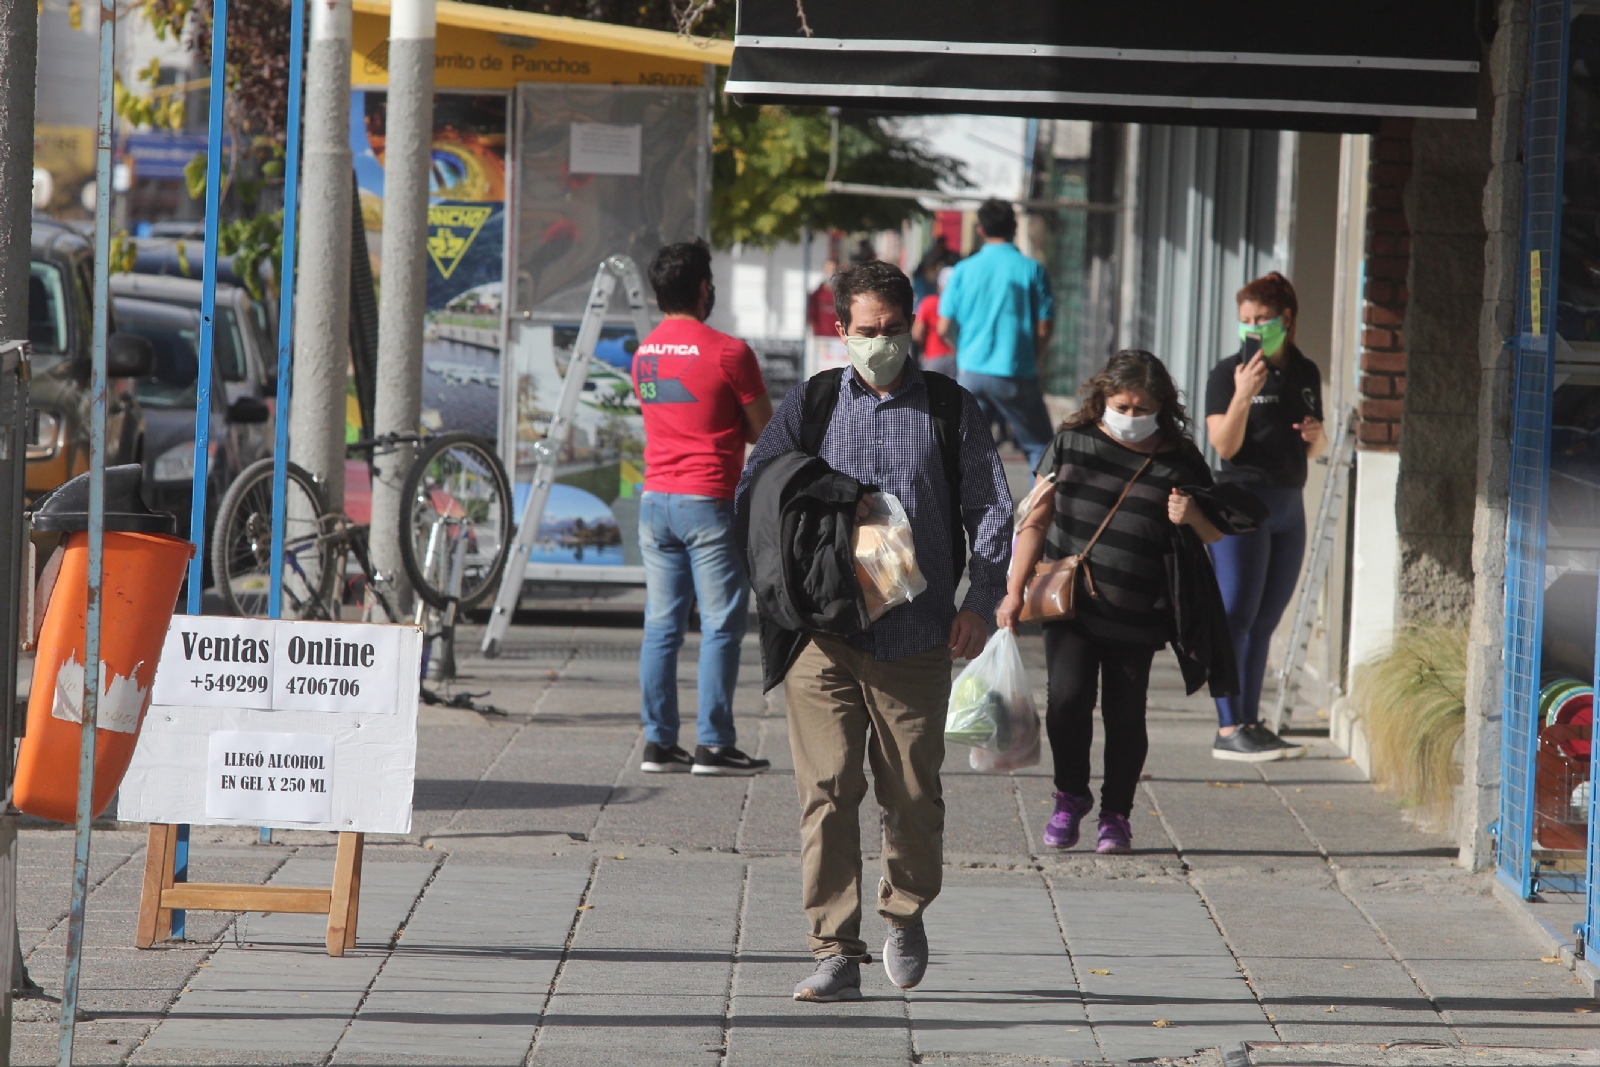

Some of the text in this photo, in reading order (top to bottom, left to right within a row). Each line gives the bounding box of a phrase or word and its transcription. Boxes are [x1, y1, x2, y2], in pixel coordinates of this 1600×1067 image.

[479, 53, 504, 71] de
[511, 54, 591, 75] Panchos
[428, 208, 482, 228] ANCHO
[637, 344, 700, 356] NAUTICA
[640, 360, 652, 376] N
[639, 382, 656, 399] 83
[181, 631, 375, 667] Ventas Online
[190, 674, 360, 697] +549299 4706706
[224, 750, 326, 770] LLEGÓ ALCOHOL
[221, 775, 327, 793] EN GEL X 250 ML
